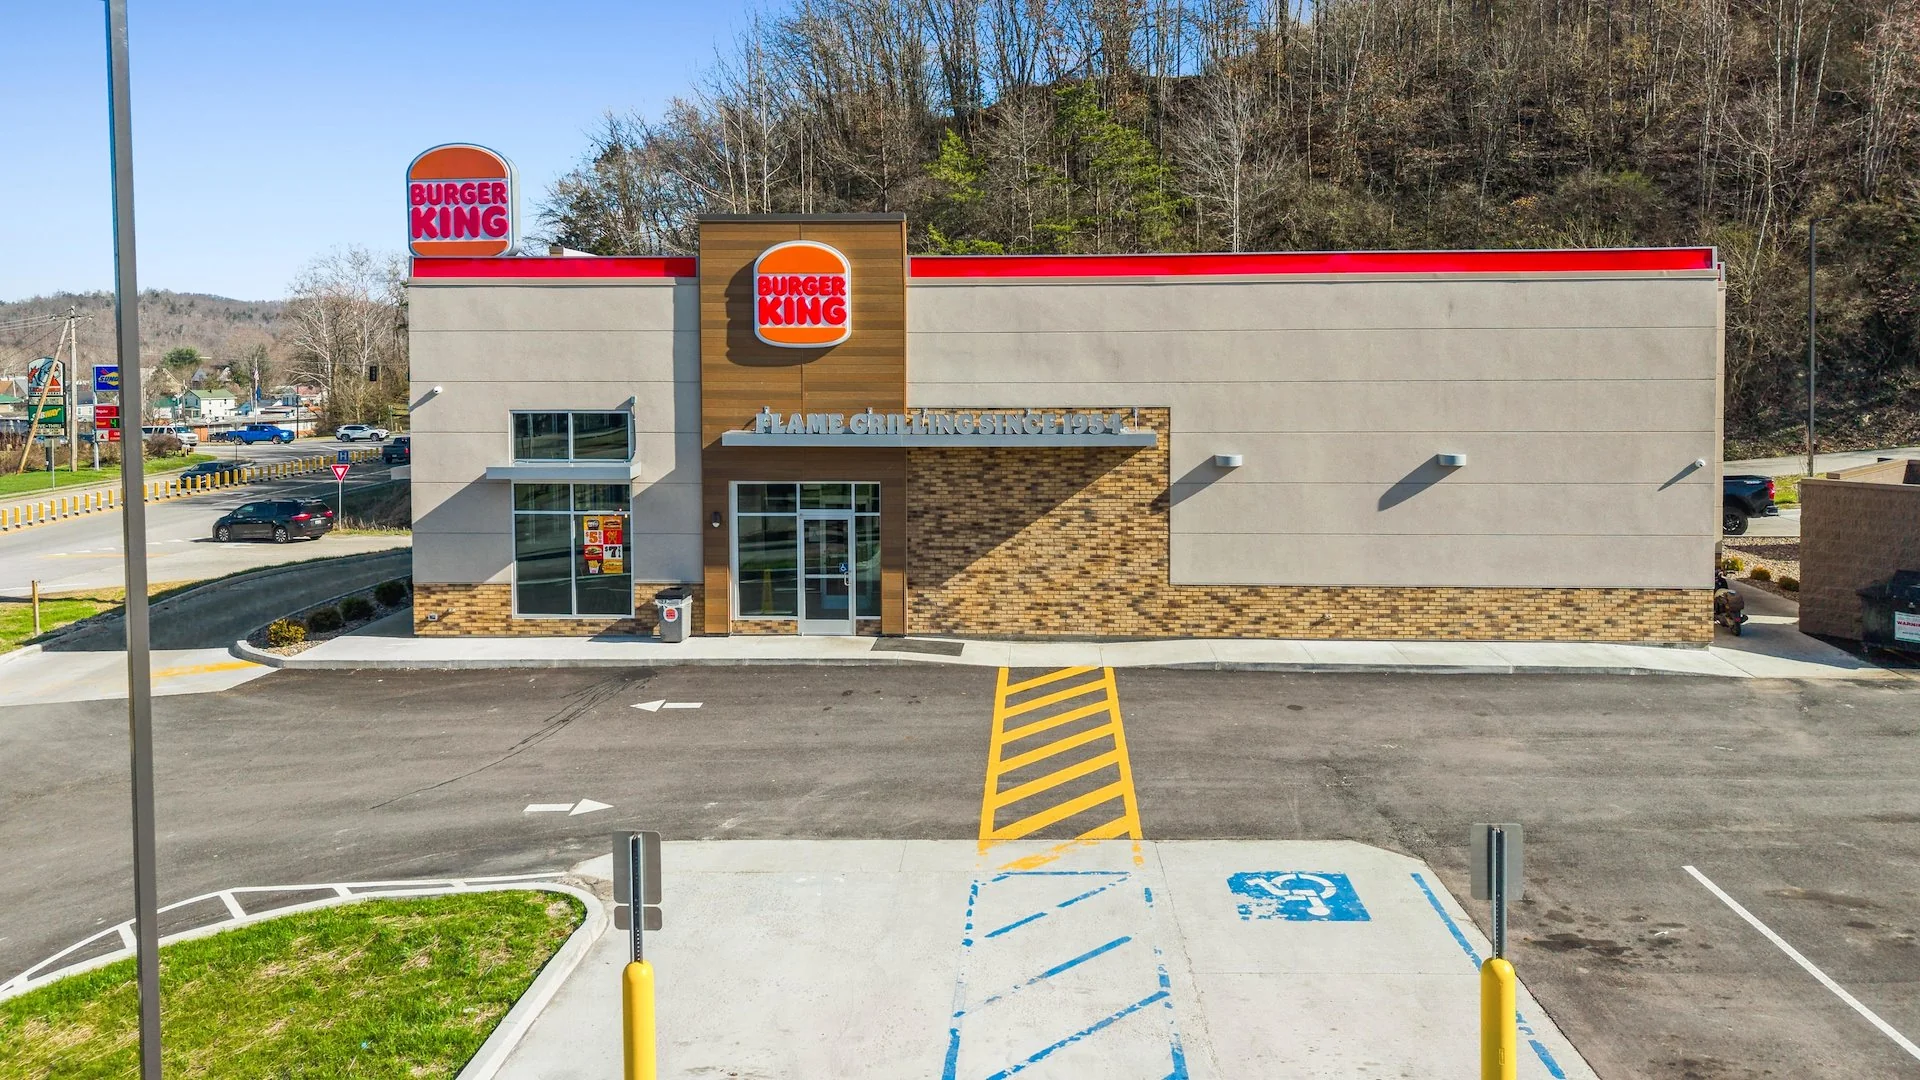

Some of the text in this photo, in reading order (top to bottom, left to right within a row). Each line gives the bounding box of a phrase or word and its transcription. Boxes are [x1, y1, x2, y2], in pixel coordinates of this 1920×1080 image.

[410, 182, 508, 206] BURGER
[411, 205, 509, 239] KING
[758, 276, 846, 296] BURGER
[758, 296, 847, 325] KING
[755, 412, 1122, 435] FLAME GRILLING SINCE 1954
